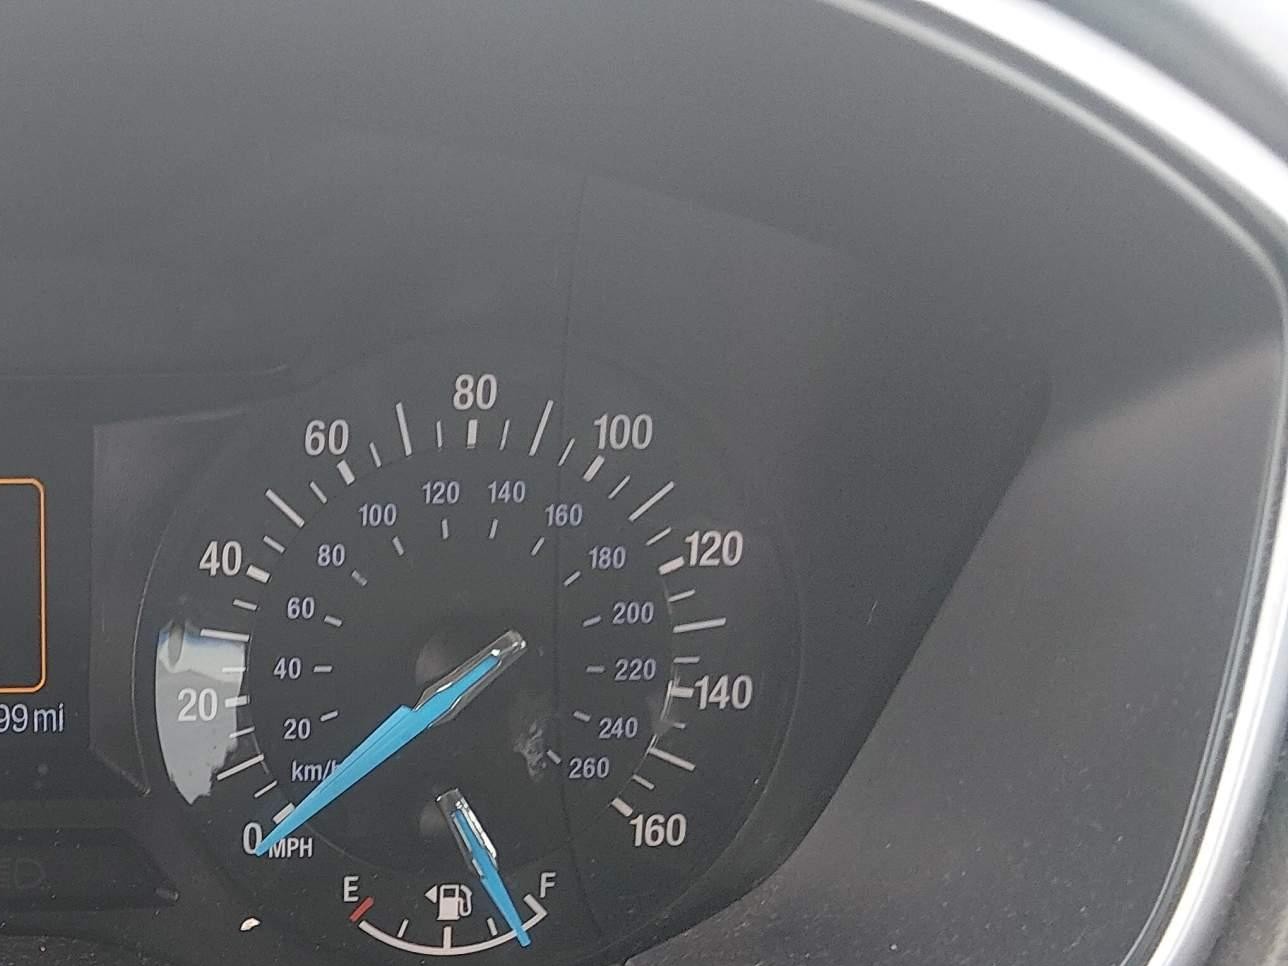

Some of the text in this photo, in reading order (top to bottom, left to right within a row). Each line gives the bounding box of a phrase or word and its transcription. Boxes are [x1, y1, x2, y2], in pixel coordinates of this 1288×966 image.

[453, 374, 498, 410] 80
[304, 420, 349, 456] 60
[593, 414, 653, 449] 100
[422, 482, 461, 504] 120
[488, 481, 526, 503] 140
[359, 505, 397, 527] 100
[545, 505, 583, 527] 160
[200, 541, 242, 576] 40
[318, 544, 345, 567] 80
[589, 547, 627, 569] 180
[684, 531, 744, 567] 120
[287, 597, 316, 620] 60
[612, 601, 654, 625] 200
[273, 658, 302, 679] 40
[615, 658, 657, 680] 220
[695, 675, 752, 709] 140
[177, 688, 218, 722] 20
[283, 719, 311, 740] 20
[599, 718, 638, 739] 240
[569, 757, 610, 779] 260
[243, 824, 313, 858] 0 MPH
[630, 813, 686, 847] 160
[343, 877, 359, 901] E
[540, 873, 556, 896] F
